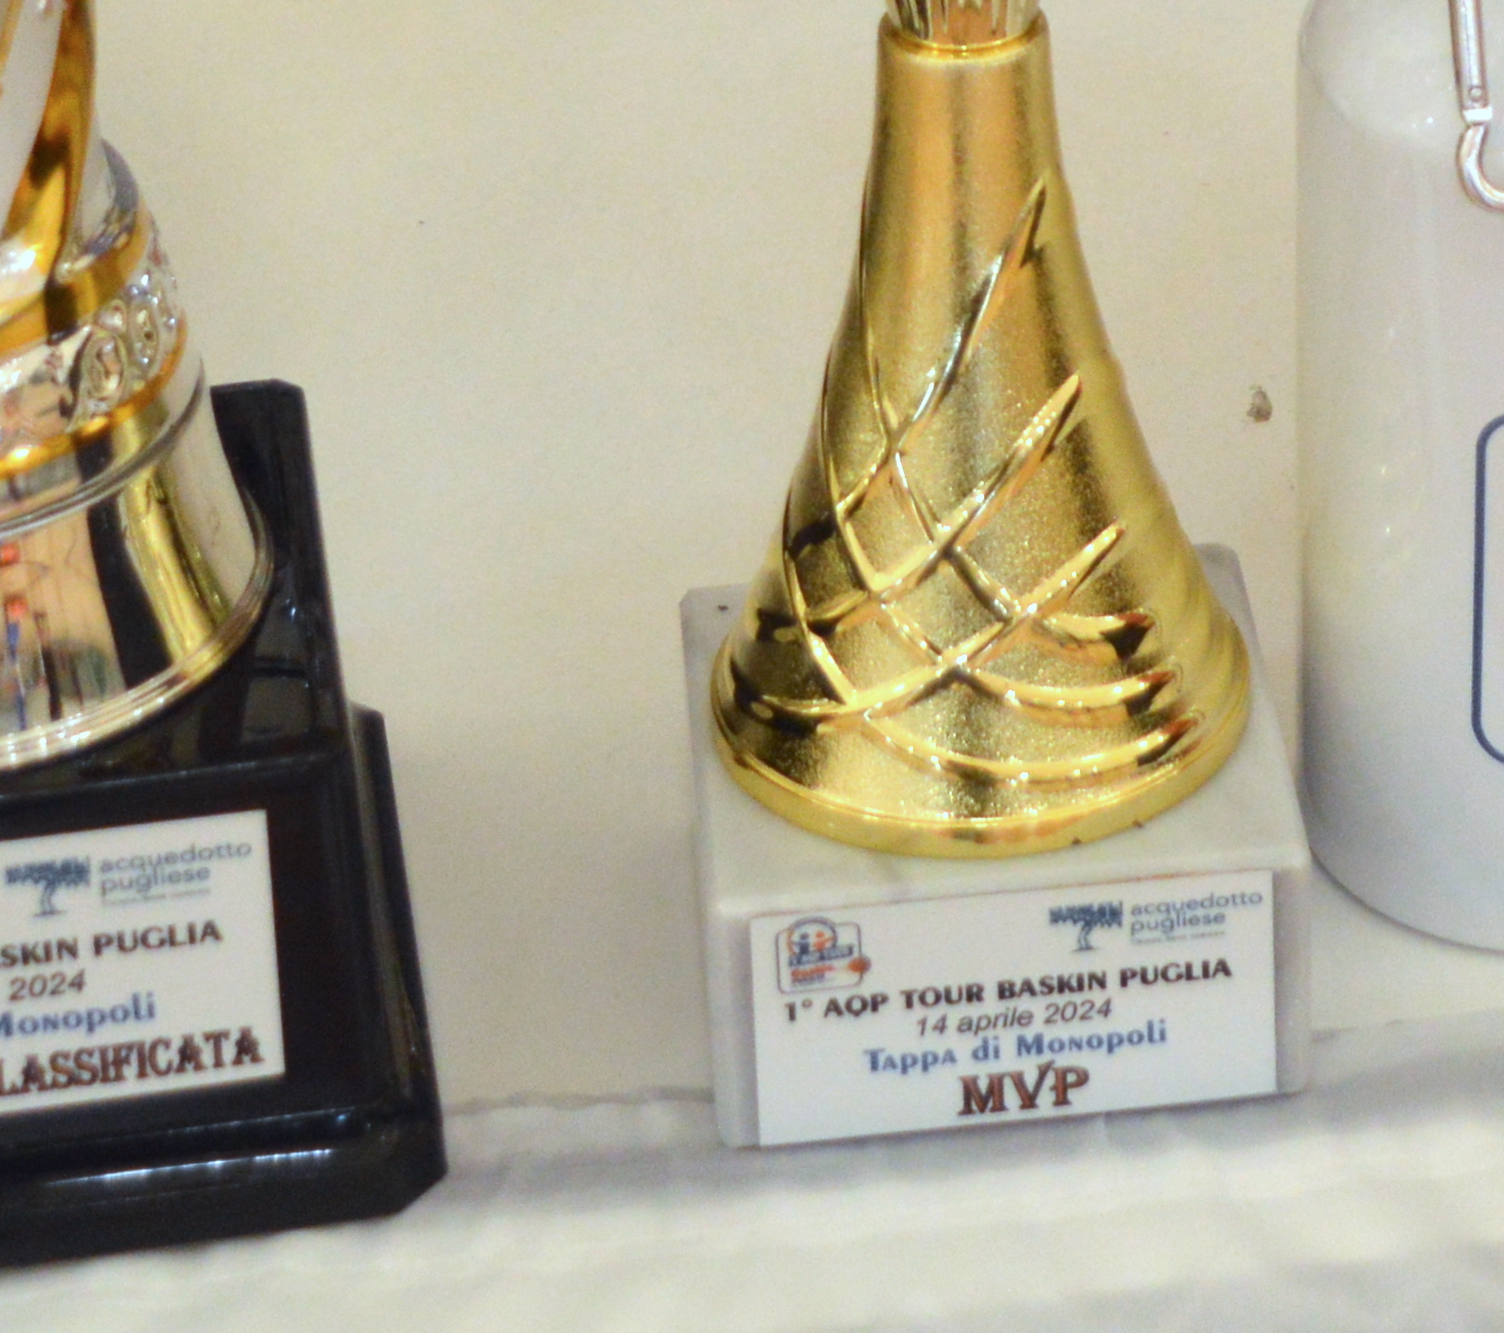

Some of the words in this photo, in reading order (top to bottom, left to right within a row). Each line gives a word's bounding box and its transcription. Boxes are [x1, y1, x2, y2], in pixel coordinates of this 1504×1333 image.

[1130, 891, 1264, 917] acquedotto
[1130, 911, 1226, 936] pugliese
[92, 918, 224, 960] PUGLIA
[8, 968, 88, 1001] 2024
[823, 993, 890, 1019] AQP
[900, 984, 985, 1011] TOUR
[997, 969, 1108, 1002] BASKIN
[1119, 957, 1233, 990] PUGLIA
[915, 1016, 949, 1038] 14
[957, 1004, 1035, 1038] aprile
[1045, 997, 1113, 1024] 2024
[971, 1036, 1002, 1063] di
[1016, 1018, 1169, 1058] Monopoli
[956, 1059, 1091, 1117] MVP
